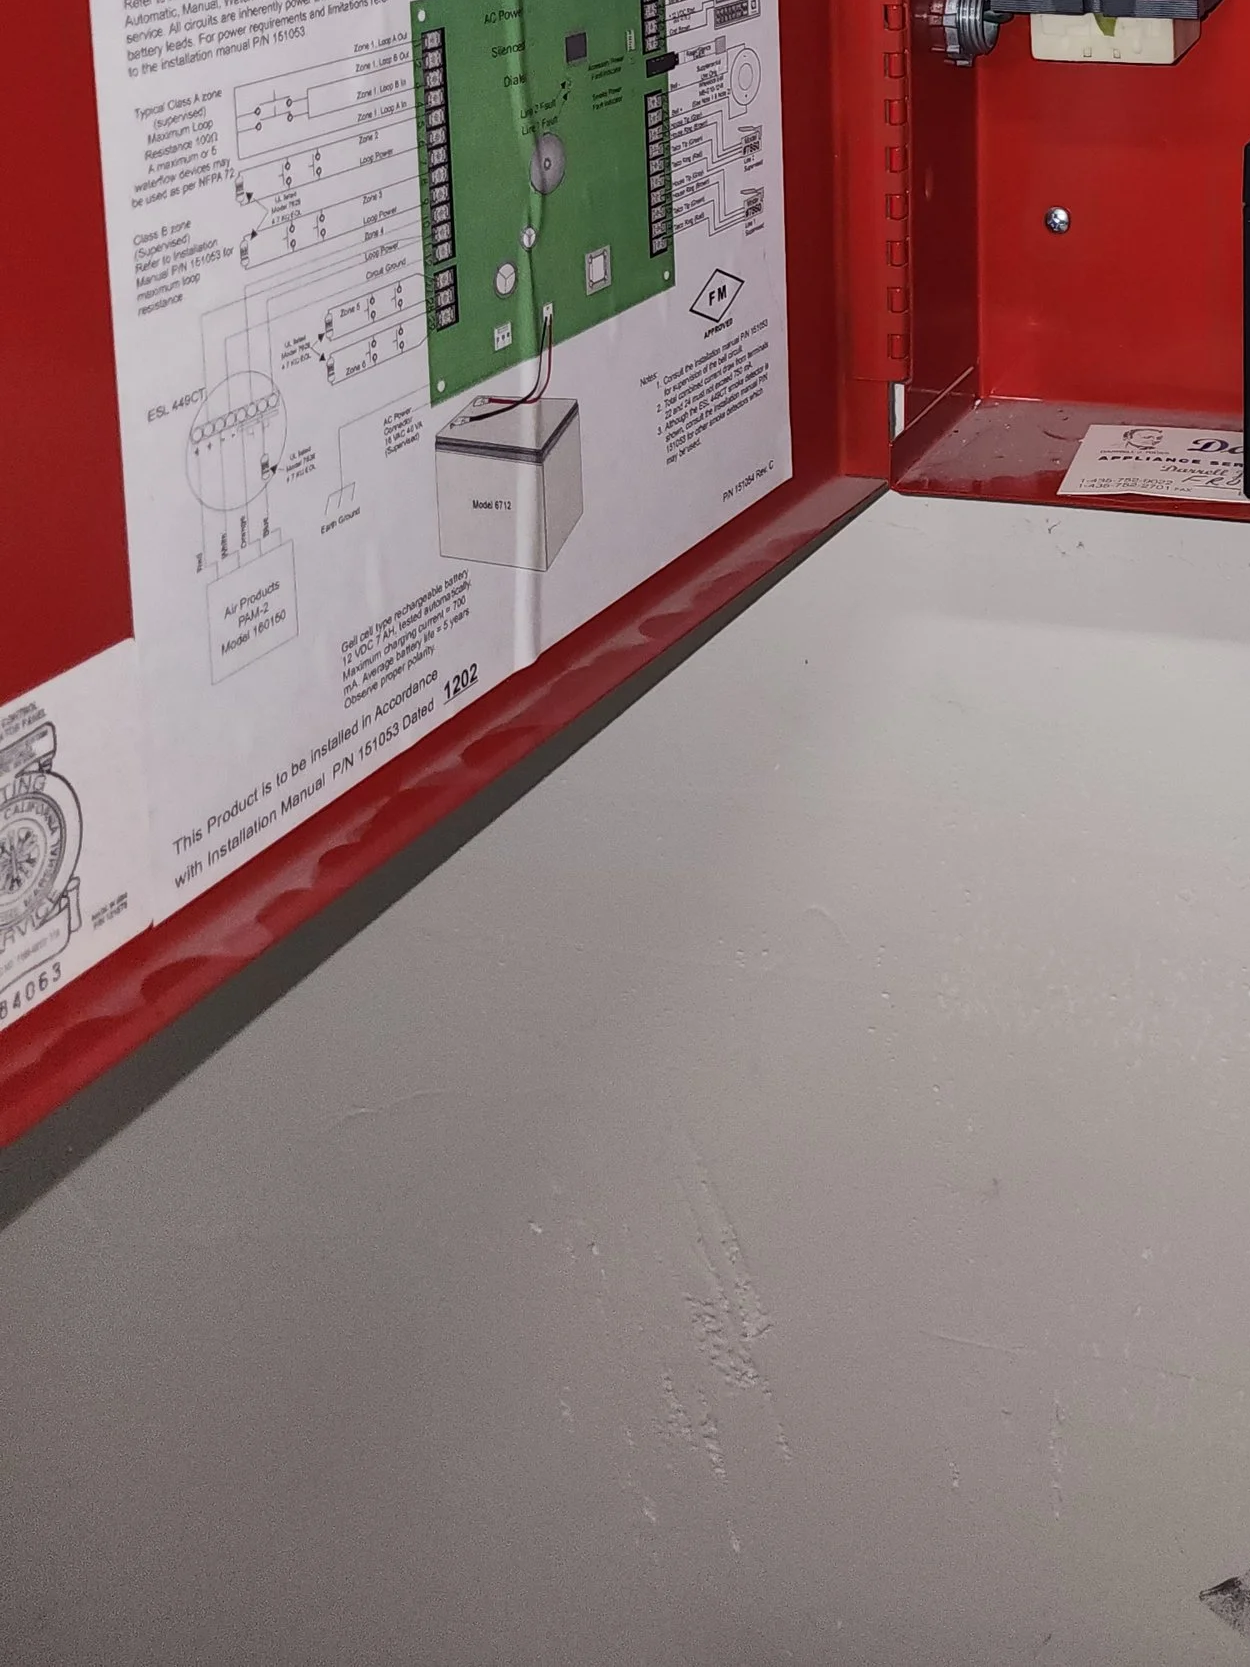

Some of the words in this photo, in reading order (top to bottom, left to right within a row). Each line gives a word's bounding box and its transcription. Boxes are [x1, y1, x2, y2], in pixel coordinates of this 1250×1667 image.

[472, 499, 493, 510] Model
[494, 500, 512, 511] 6712
[1098, 455, 1202, 465] APPLIANCE
[172, 828, 203, 855] This
[207, 787, 259, 834] Product
[261, 781, 273, 797] is
[276, 771, 288, 787] to
[291, 758, 307, 777] be
[310, 719, 359, 764] installed
[361, 714, 372, 730] in
[374, 669, 438, 722] Accordance
[174, 860, 203, 888] with
[207, 809, 277, 867] Installation
[280, 772, 326, 816] Manual
[332, 752, 354, 780] P/N
[358, 721, 400, 761] 151053
[402, 697, 434, 731] Dated
[443, 663, 478, 695] 1202
